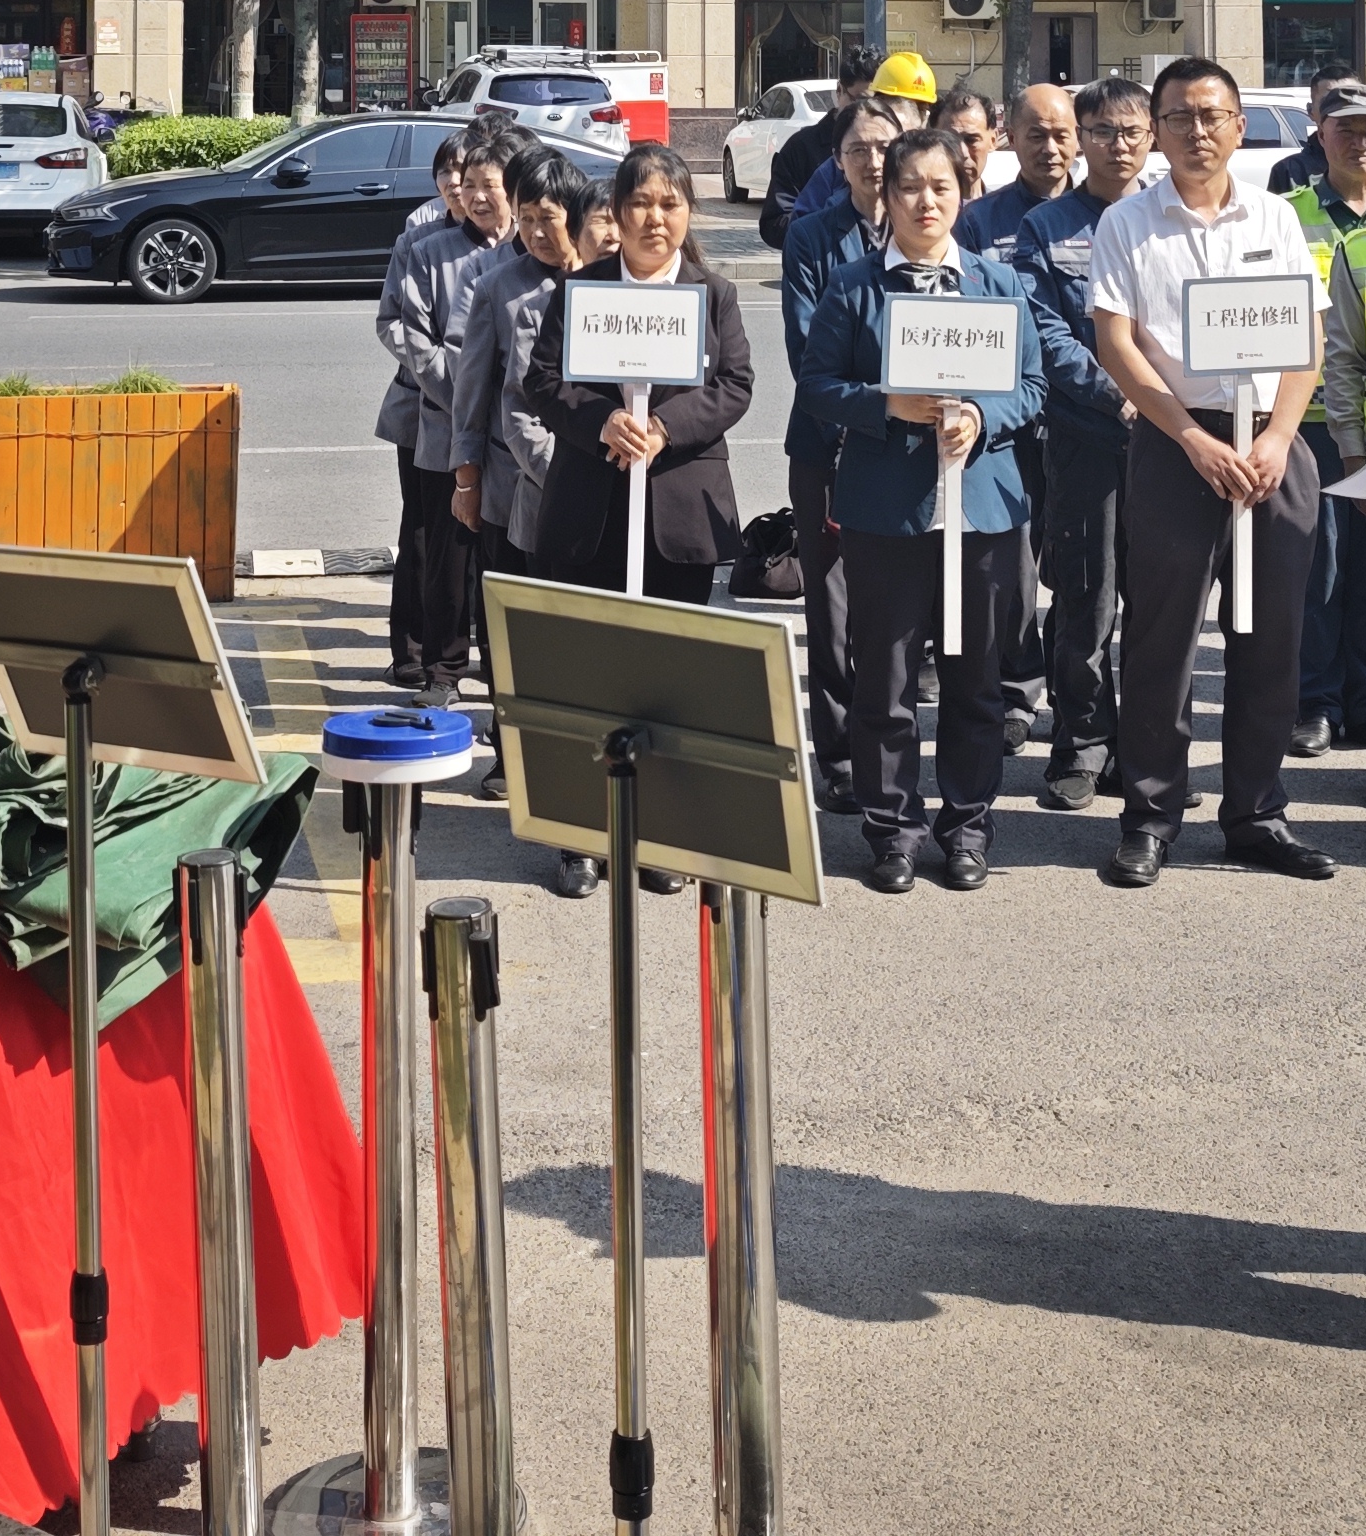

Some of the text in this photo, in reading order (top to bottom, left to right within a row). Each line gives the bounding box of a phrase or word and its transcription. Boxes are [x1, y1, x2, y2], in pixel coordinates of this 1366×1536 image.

[581, 313, 687, 337] 后勤保障组
[1199, 305, 1299, 328] 工程抢修组
[901, 326, 1006, 350] 医疗救护组
